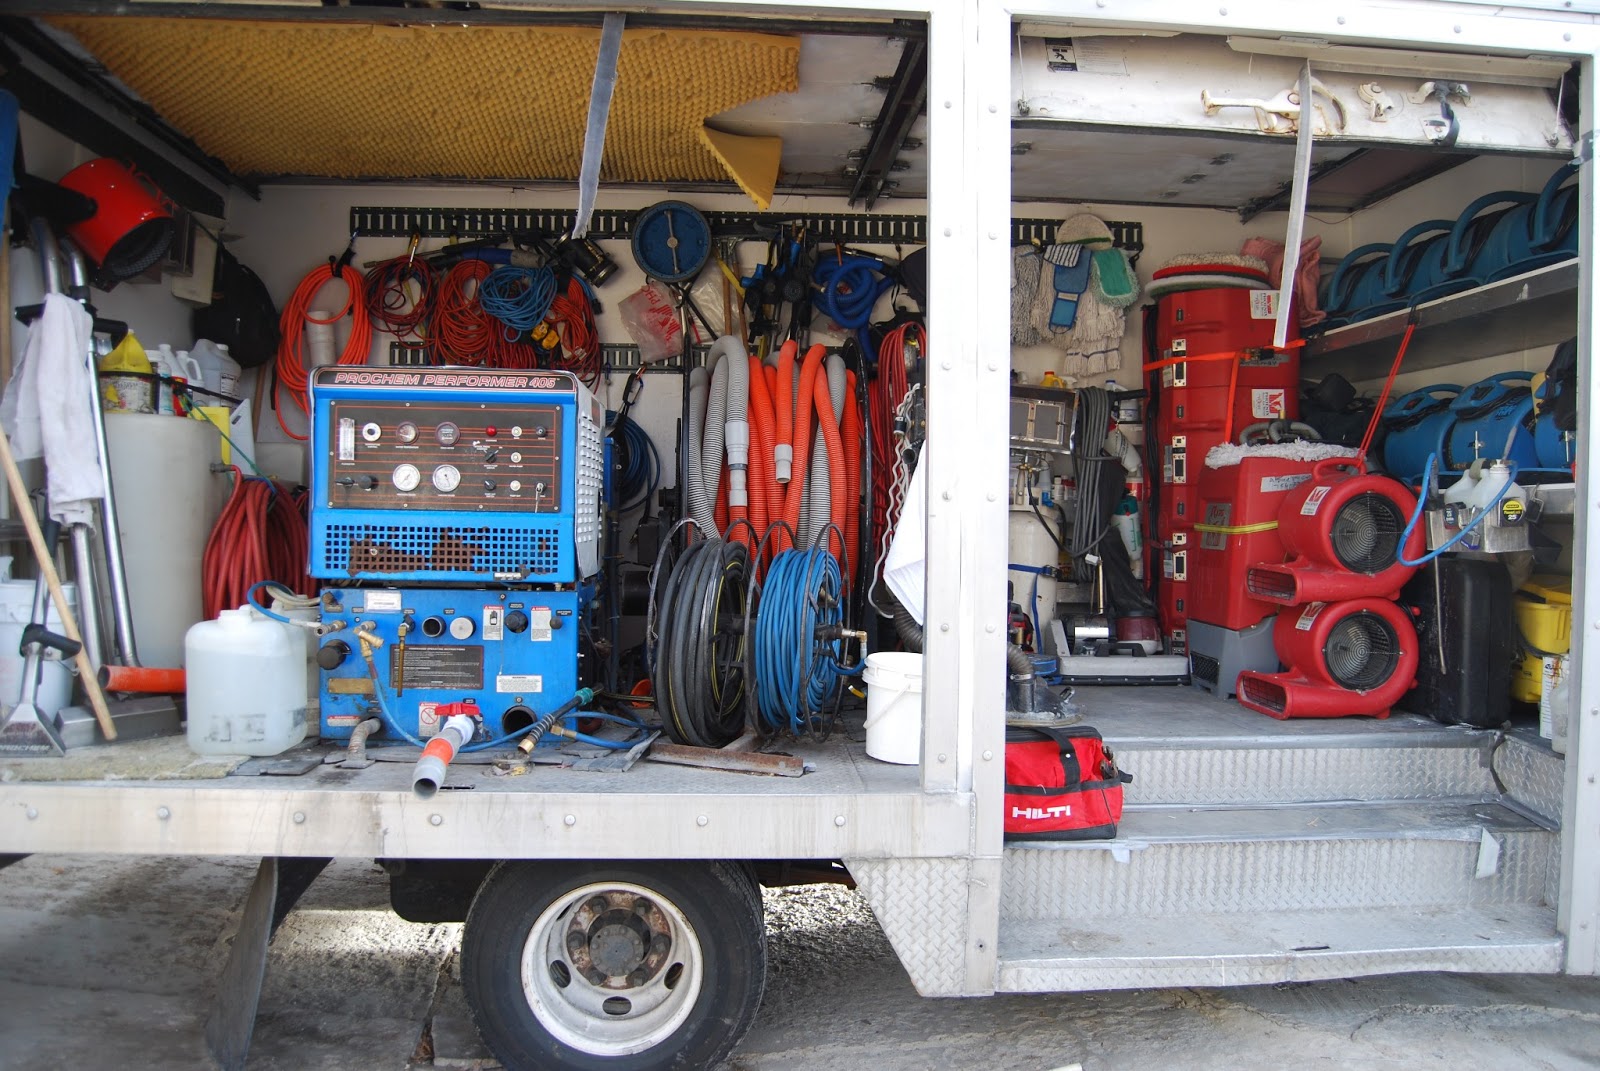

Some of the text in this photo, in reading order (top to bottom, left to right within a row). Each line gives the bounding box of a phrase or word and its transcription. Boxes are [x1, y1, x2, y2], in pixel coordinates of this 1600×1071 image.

[334, 372, 420, 386] PROCHEM
[422, 375, 529, 388] PERFORMER
[1012, 804, 1071, 819] HILTI
